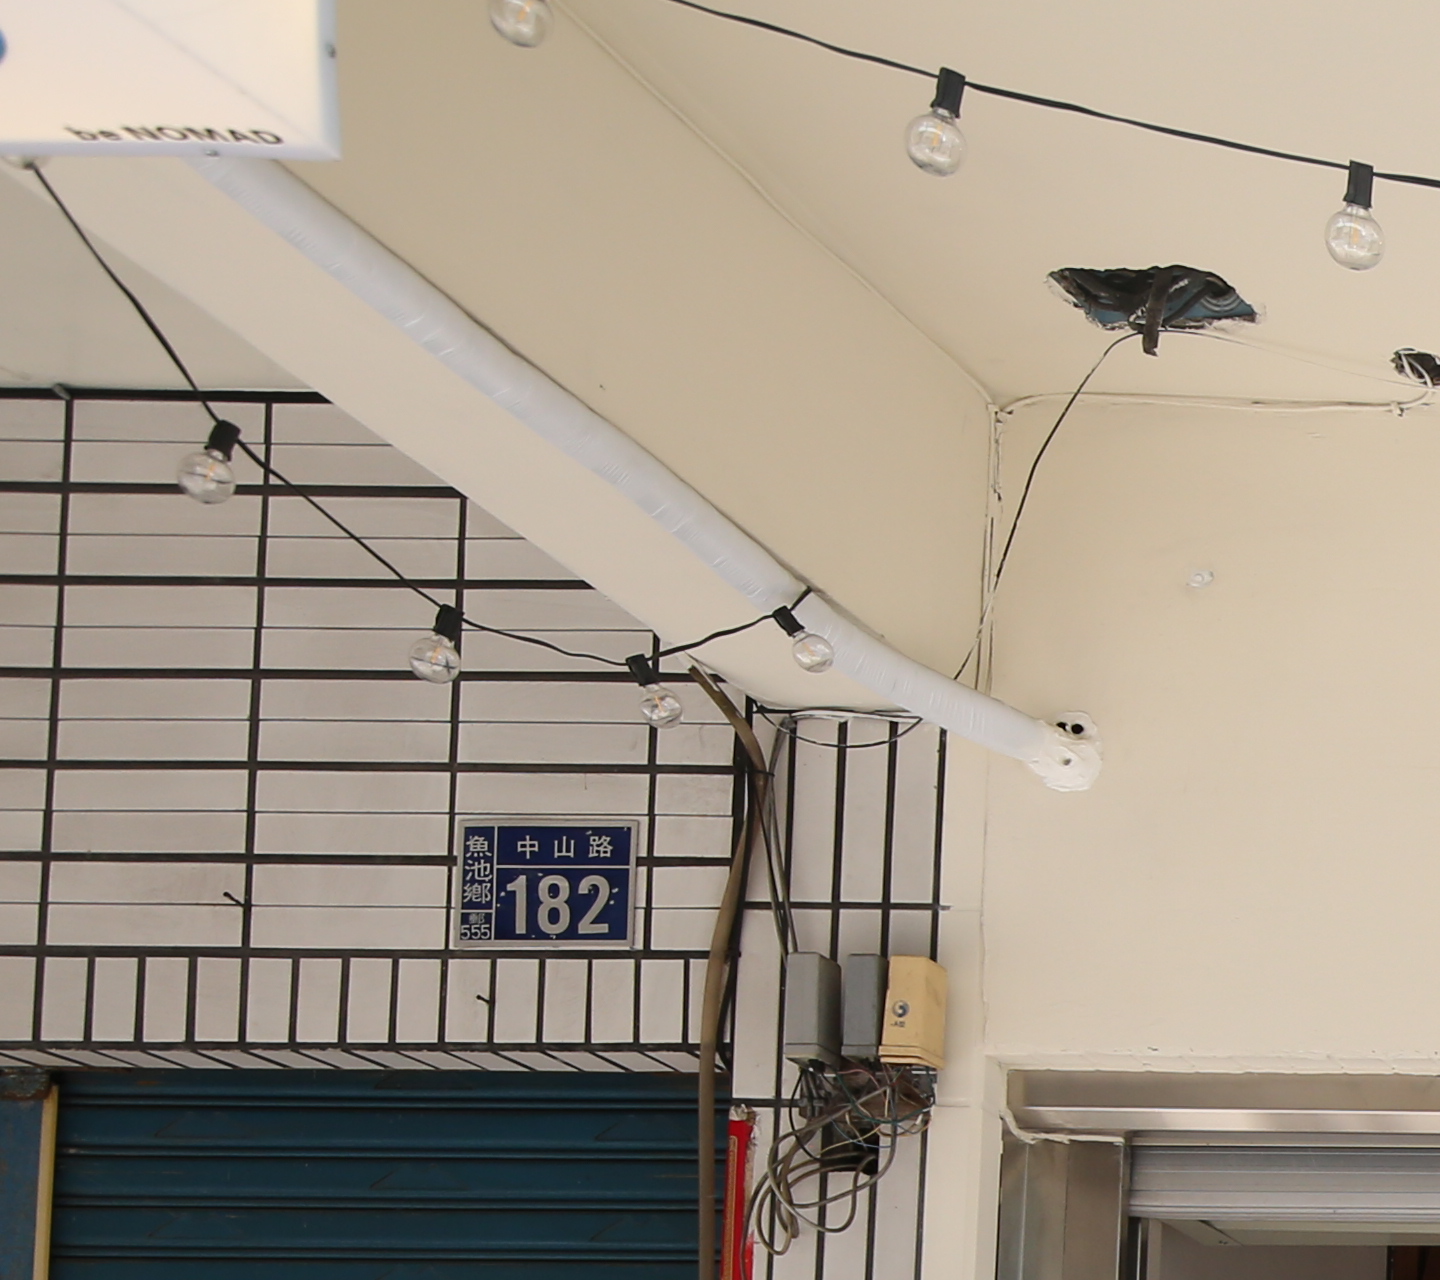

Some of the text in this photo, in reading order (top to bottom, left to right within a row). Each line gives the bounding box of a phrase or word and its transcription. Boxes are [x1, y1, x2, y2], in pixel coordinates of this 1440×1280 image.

[64, 126, 284, 145] be NOMAD
[516, 834, 614, 860] 中山路
[462, 834, 493, 904] 魚池鄉
[506, 874, 611, 935] 182
[460, 924, 491, 940] 555
